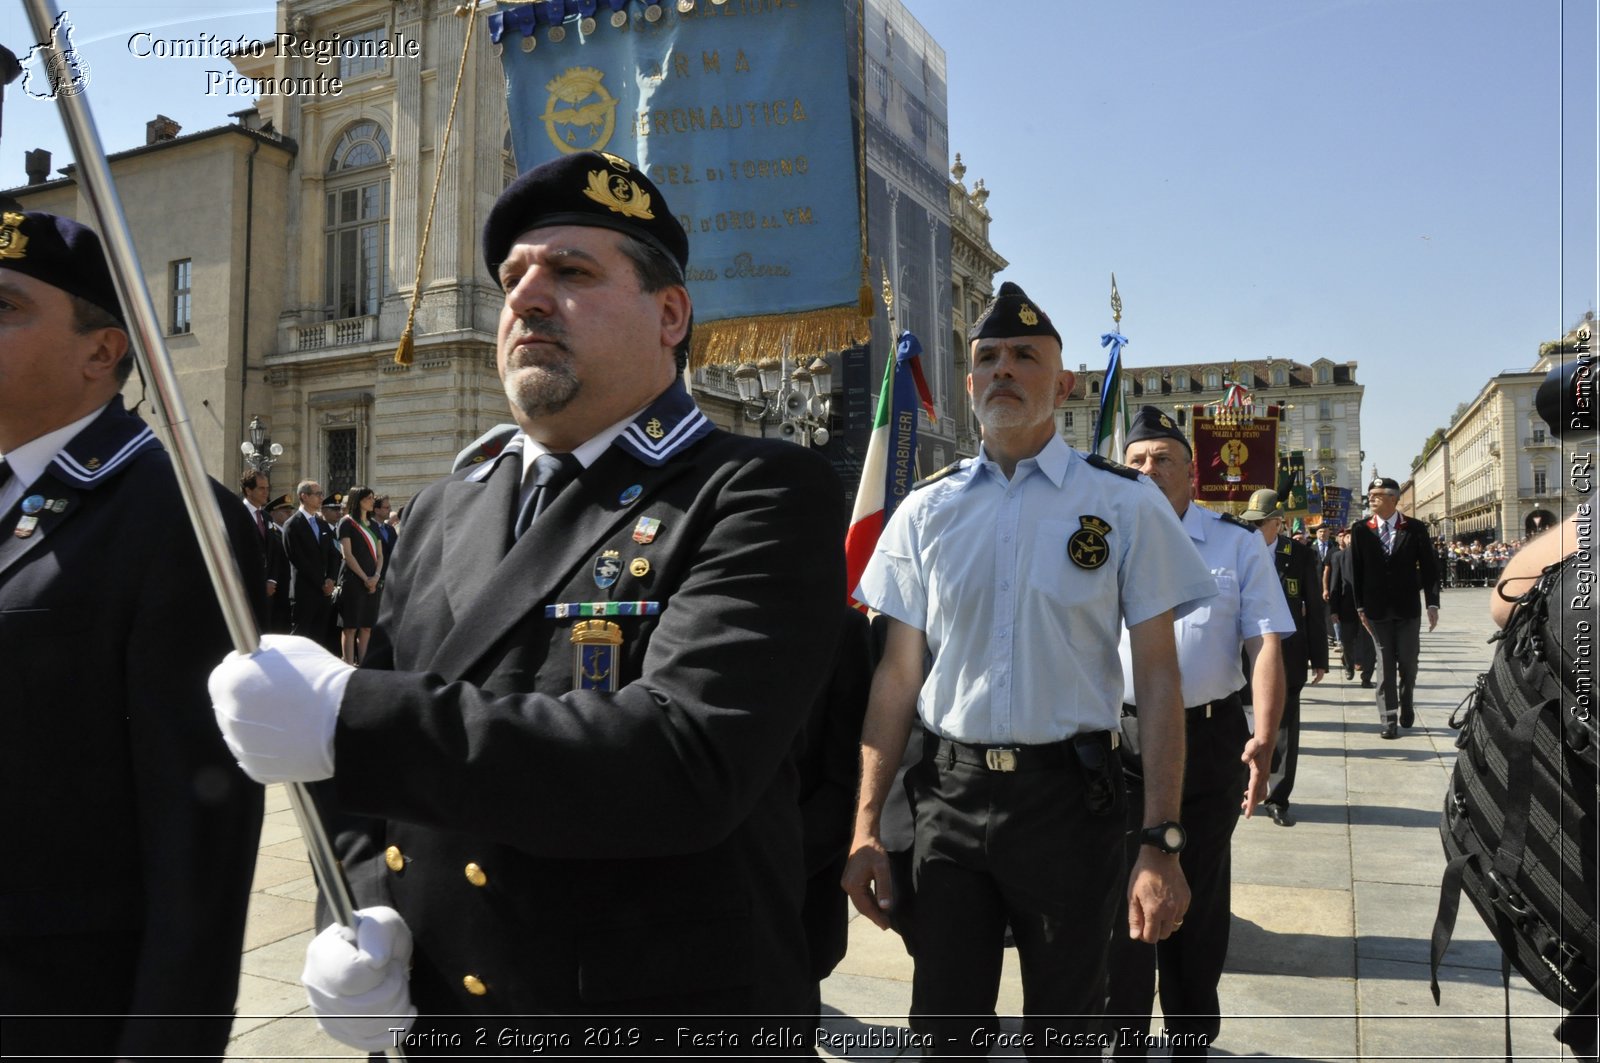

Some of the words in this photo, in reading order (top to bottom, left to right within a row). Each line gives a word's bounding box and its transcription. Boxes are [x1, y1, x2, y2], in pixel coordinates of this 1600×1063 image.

[651, 48, 750, 81] ARMA
[631, 97, 807, 138] AERONAUTICA
[729, 154, 809, 181] TORINO
[893, 411, 913, 496] CARABINIERI
[1202, 484, 1230, 492] SEZIONE
